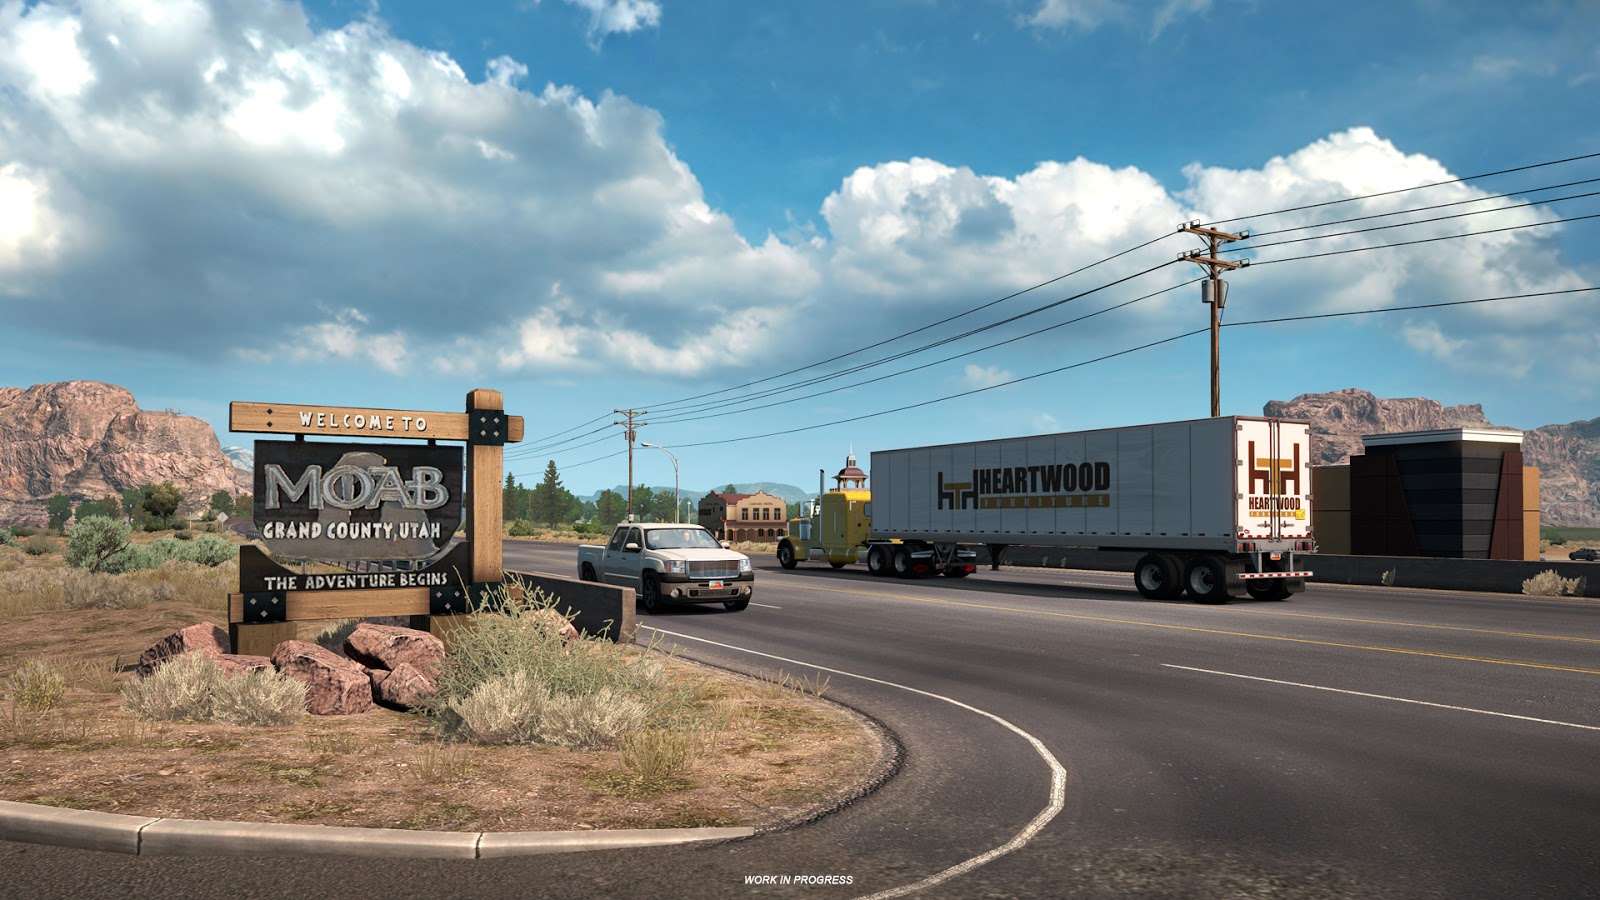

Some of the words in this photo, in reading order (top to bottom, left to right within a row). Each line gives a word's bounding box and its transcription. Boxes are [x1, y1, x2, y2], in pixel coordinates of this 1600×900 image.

[299, 411, 393, 431] WELCOME
[401, 416, 428, 431] TO
[264, 463, 450, 510] MOAB
[979, 461, 1111, 495] HEARTWOOD
[984, 495, 1105, 508] FURNITURE
[263, 521, 323, 540] GRAND
[399, 522, 441, 540] UTAH
[264, 576, 297, 591] THE
[305, 573, 396, 590] ADVENTURE
[400, 571, 448, 588] BEGINS
